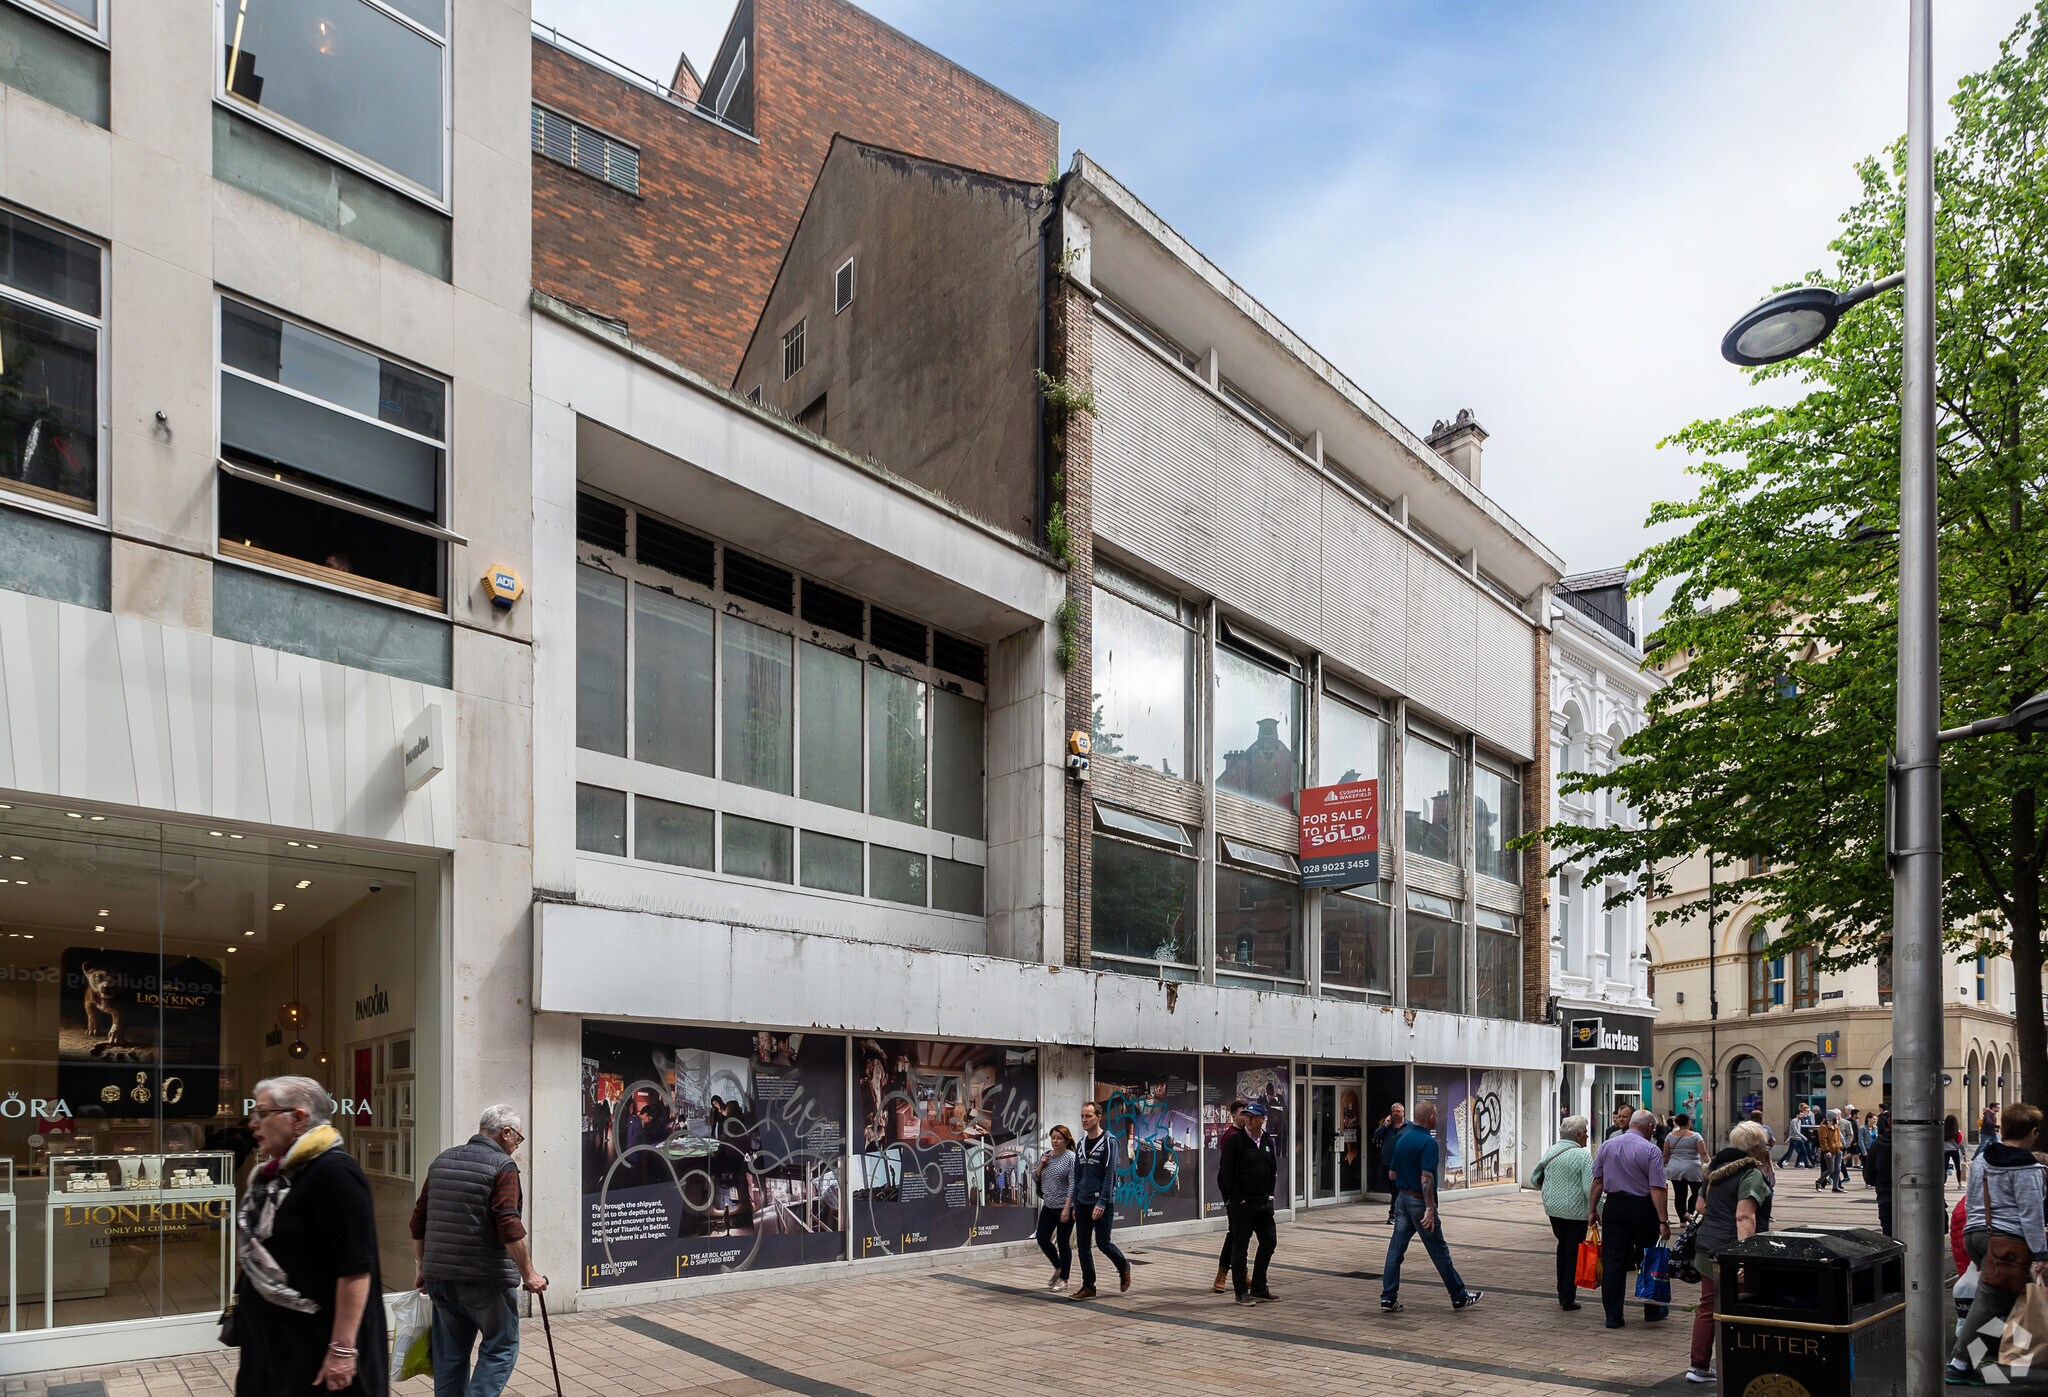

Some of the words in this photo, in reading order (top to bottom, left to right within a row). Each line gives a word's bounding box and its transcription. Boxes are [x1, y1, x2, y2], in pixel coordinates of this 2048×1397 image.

[496, 573, 514, 589] ADT
[1340, 788, 1366, 796] CUSHMAN
[1340, 792, 1372, 800] WAKEFIELD
[1303, 814, 1328, 826] FOR
[1331, 808, 1362, 822] SALE
[1303, 827, 1320, 838] TO
[1312, 826, 1366, 846] SOLD
[1303, 864, 1320, 874] 028
[1322, 862, 1344, 872] 9023
[1348, 860, 1370, 869] 3455
[137, 992, 168, 1004] LION
[172, 996, 206, 1006] KING
[355, 988, 389, 1021] PANDORA
[1825, 1039, 1832, 1053] 8
[63, 1204, 140, 1226] LION
[148, 1198, 228, 1221] KING
[592, 1204, 602, 1212] Fly
[604, 1202, 626, 1210] hrough
[636, 1200, 662, 1208] shipyard,
[1206, 1202, 1210, 1211] 8
[104, 1227, 130, 1235] ONLY
[148, 1224, 187, 1232] CINEMAS
[172, 1232, 198, 1240] ROAR
[866, 1236, 873, 1248] 3
[905, 1233, 911, 1244] 4
[681, 1255, 688, 1267] 2
[696, 1257, 722, 1265] SHIPYARD
[591, 1264, 600, 1277] 1
[601, 1268, 626, 1276] BELFST
[1737, 1331, 1819, 1356] LITTER
